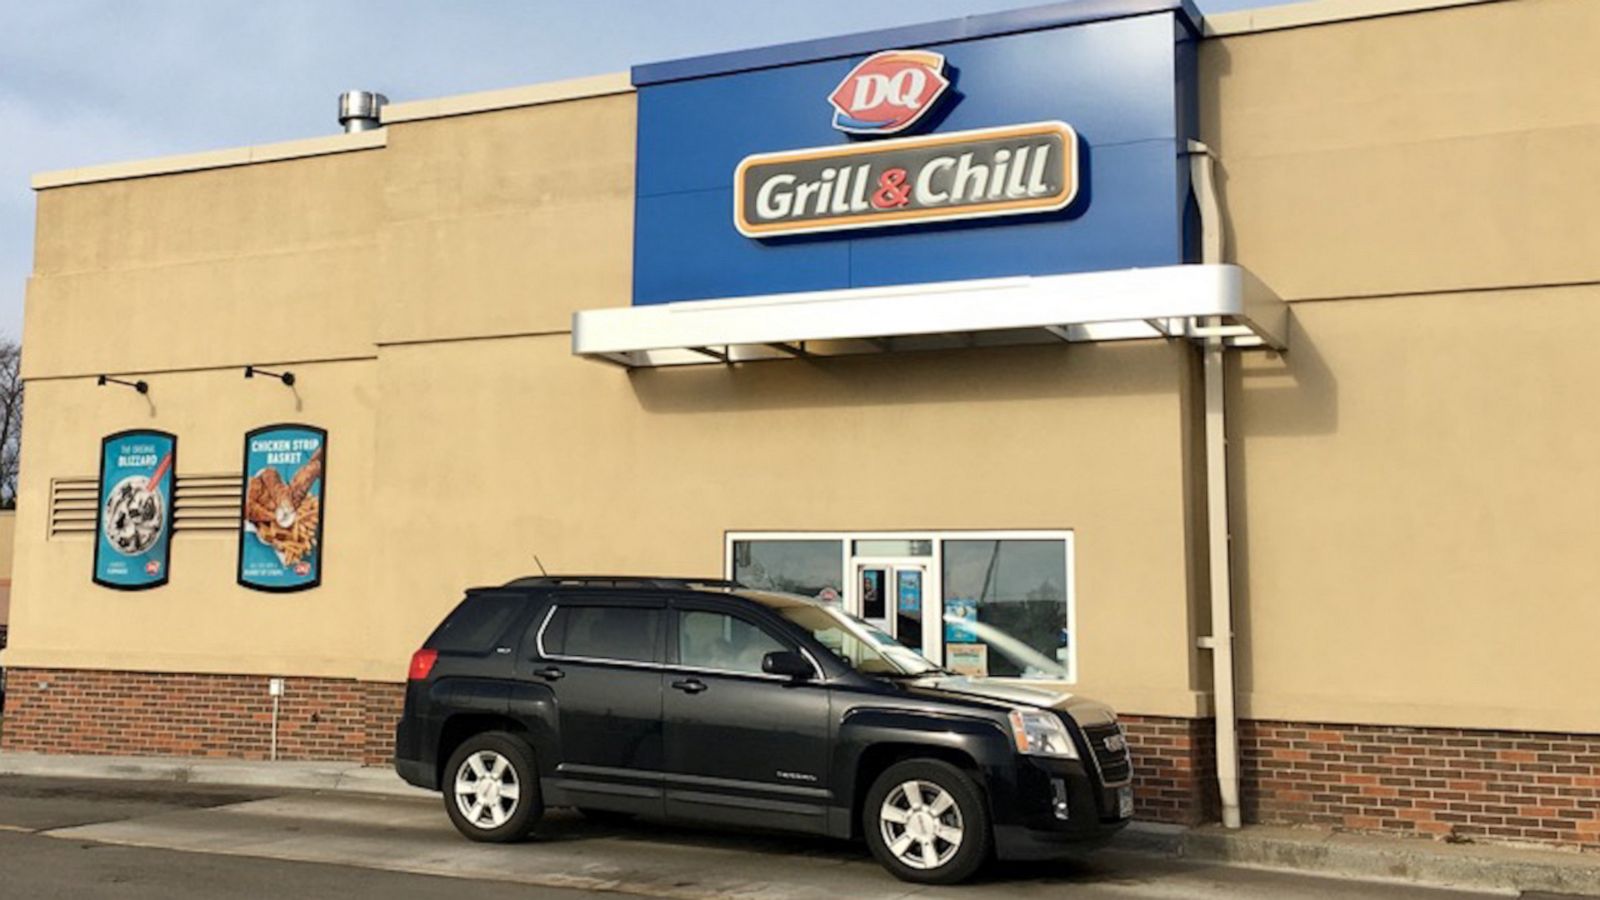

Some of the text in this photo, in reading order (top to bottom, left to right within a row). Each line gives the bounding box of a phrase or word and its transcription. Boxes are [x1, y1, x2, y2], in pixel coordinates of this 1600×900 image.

[853, 68, 927, 111] DQ
[252, 438, 319, 452] CHICKEN STRIP
[117, 454, 158, 467] BLIZZARD
[267, 451, 301, 464] BASKET
